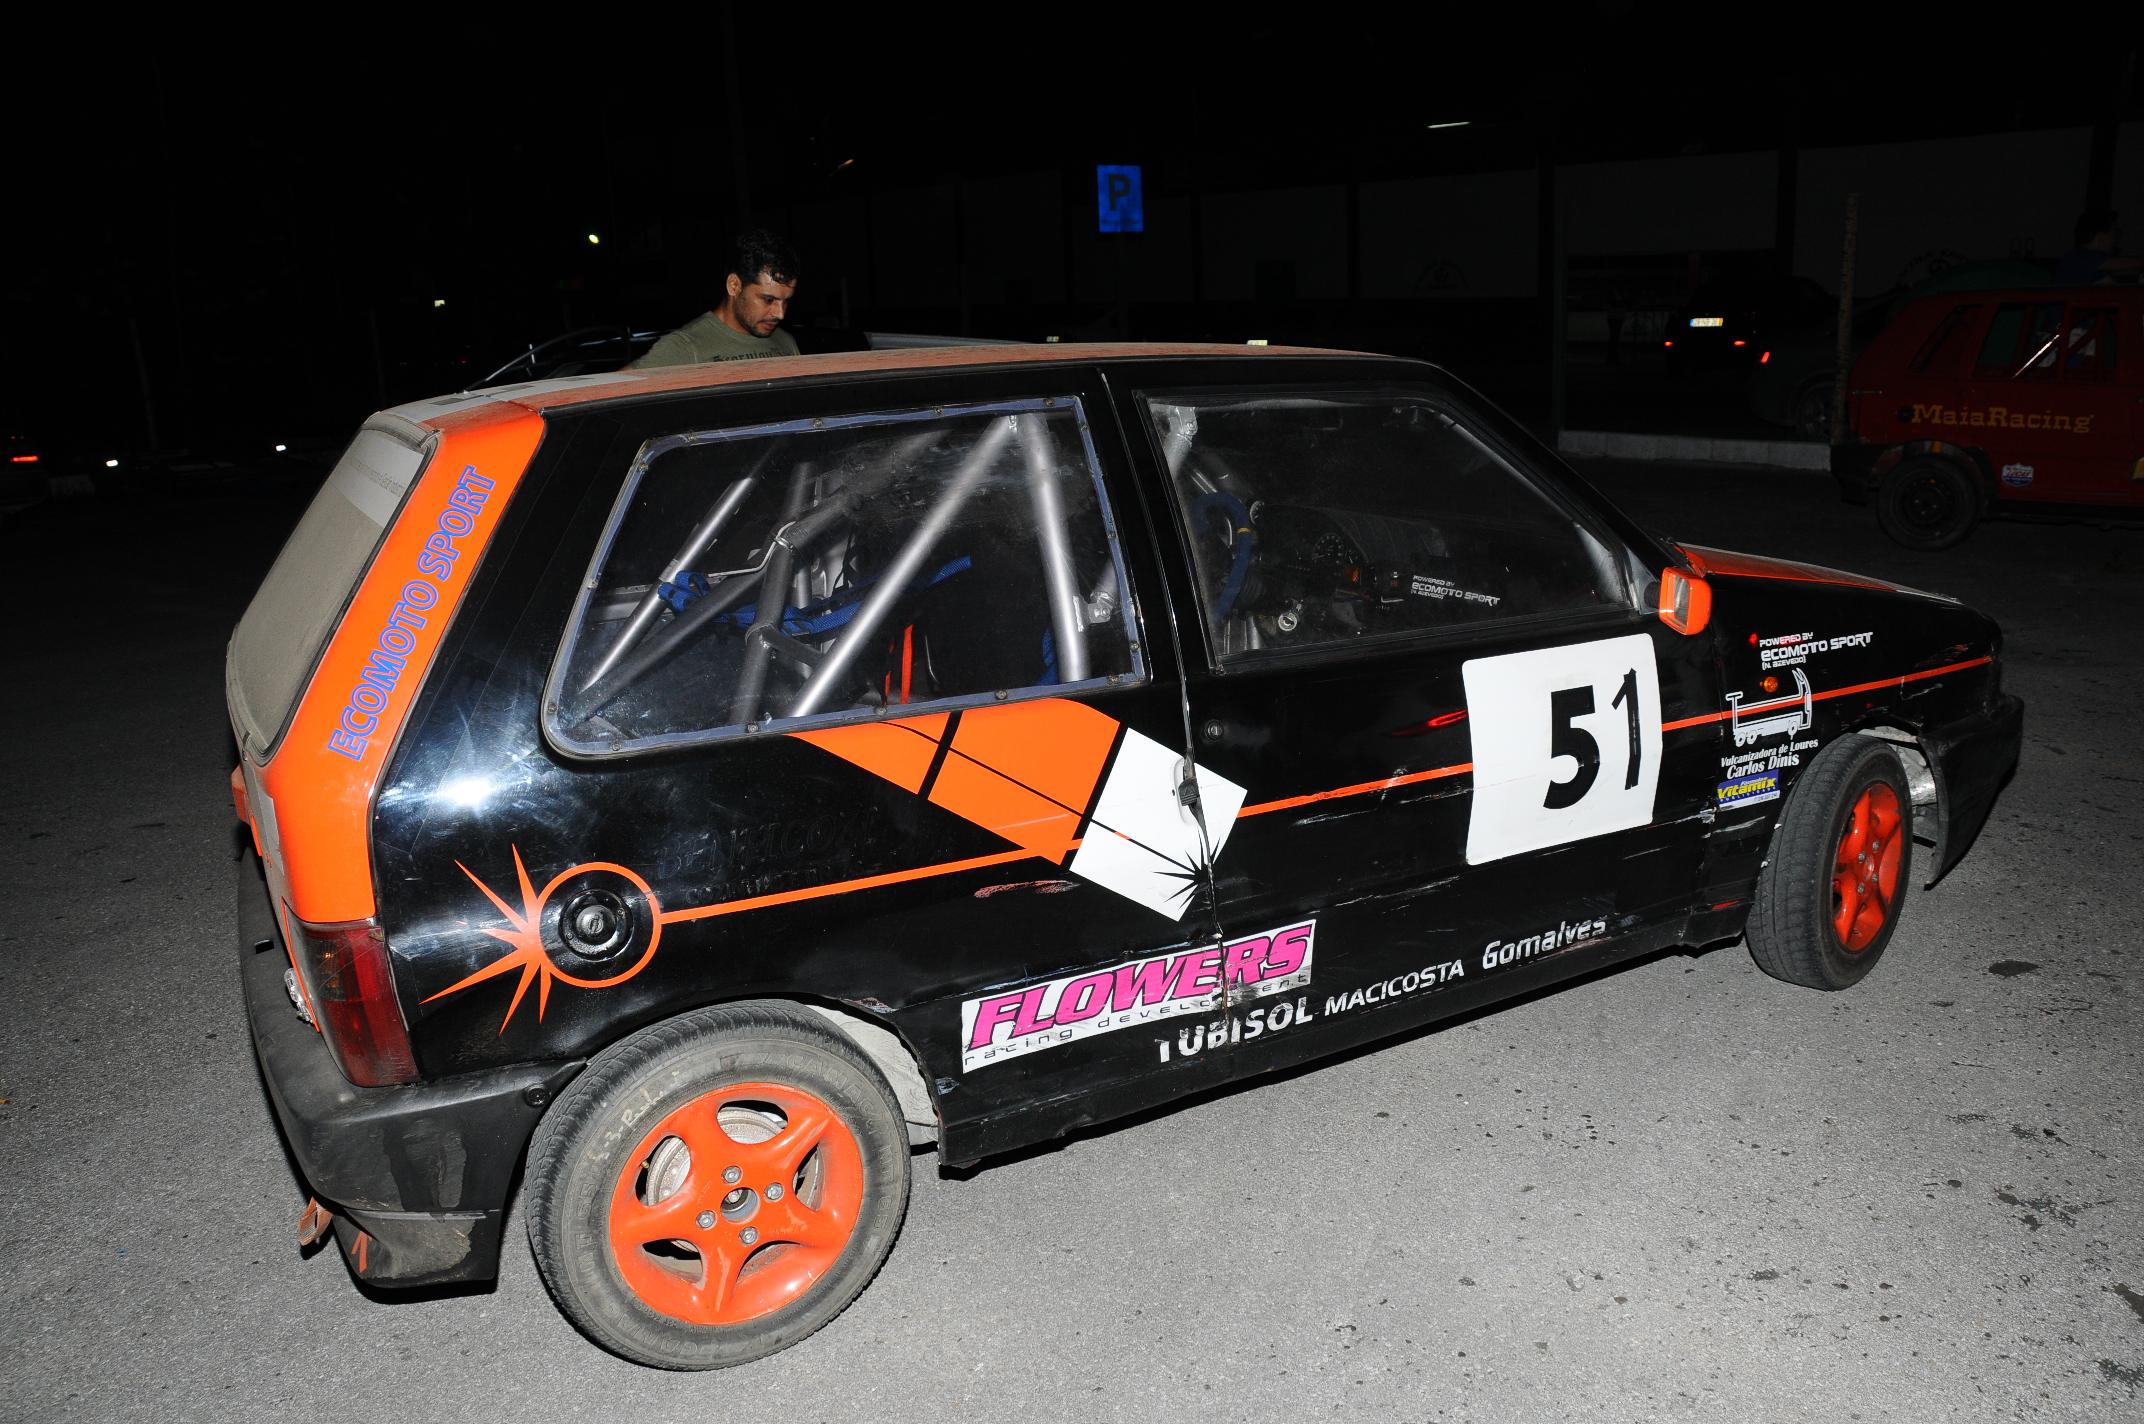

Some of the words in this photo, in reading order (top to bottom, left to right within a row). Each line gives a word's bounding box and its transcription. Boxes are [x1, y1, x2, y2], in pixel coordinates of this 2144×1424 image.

[1108, 174, 1130, 211] P
[1911, 403, 2095, 433] MaiaRacing
[327, 579, 438, 761] ECOMOTO
[417, 465, 496, 581] SPORT
[1464, 592, 1500, 607] SPORT
[1759, 634, 1801, 648] POWERED
[1802, 632, 1813, 641] BY
[1830, 632, 1873, 650] SPORT
[1543, 667, 1641, 809] 51
[1721, 748, 1777, 767] Vulcanizadora
[1778, 744, 1788, 754] de
[1790, 739, 1819, 751] Loures
[1726, 760, 1765, 779] Carlos
[1767, 752, 1799, 770] Dinis
[968, 924, 1312, 1051] FLOWERS
[1325, 959, 1465, 1016] MACICOSTA
[964, 1028, 1073, 1067] racing
[1155, 996, 1313, 1063] TUBISOL
